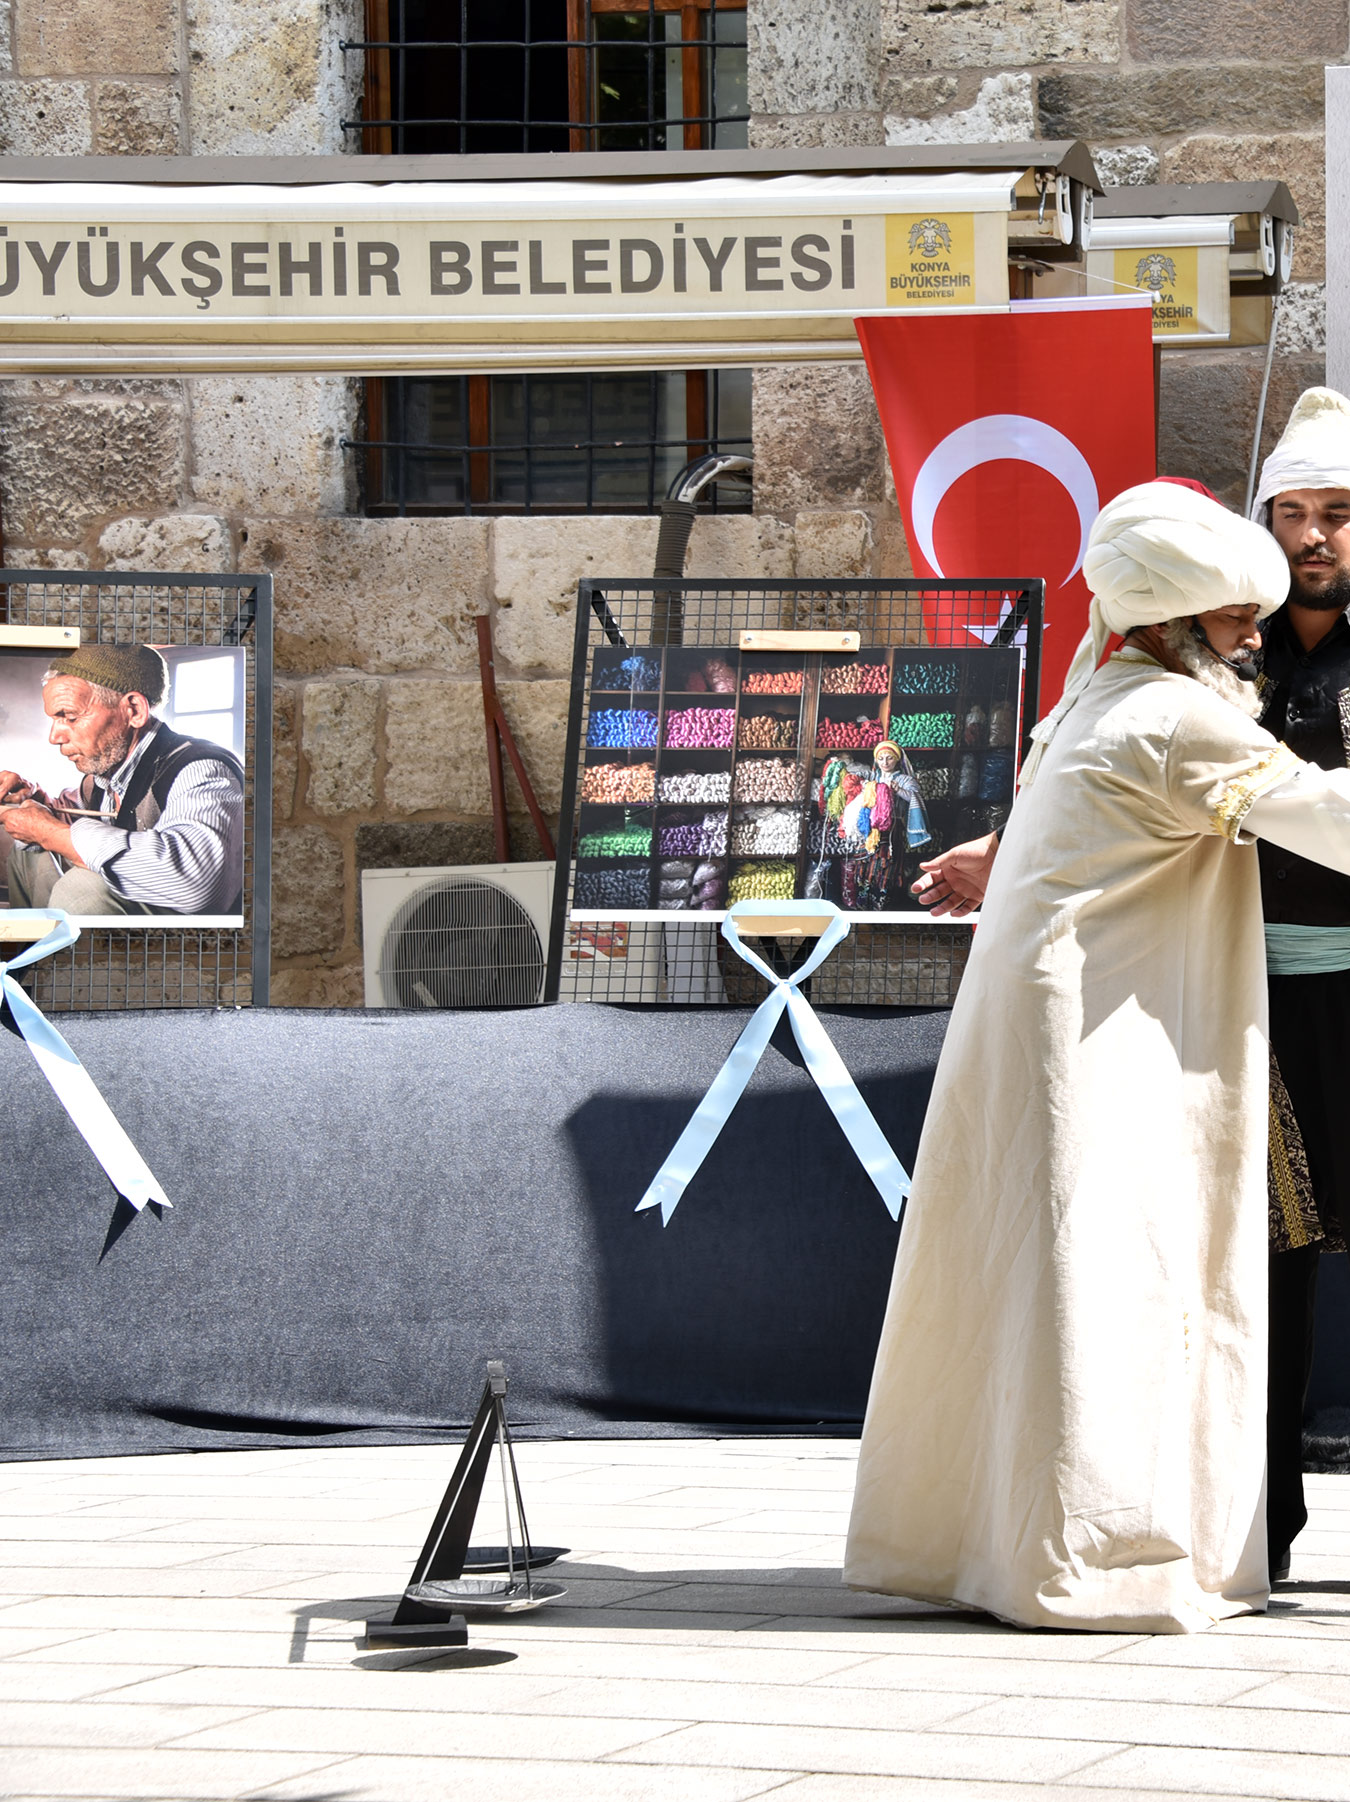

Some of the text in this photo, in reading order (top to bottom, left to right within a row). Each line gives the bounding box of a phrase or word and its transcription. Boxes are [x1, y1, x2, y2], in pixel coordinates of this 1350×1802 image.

[430, 218, 856, 296] BELEDİYESİ
[910, 262, 951, 273] KONYA
[889, 272, 971, 289] BÜYÜKŞEHİR
[906, 289, 955, 299] BELEDİYESİ
[1152, 304, 1194, 320] KŞEHİR
[1152, 319, 1180, 328] DİYESİ
